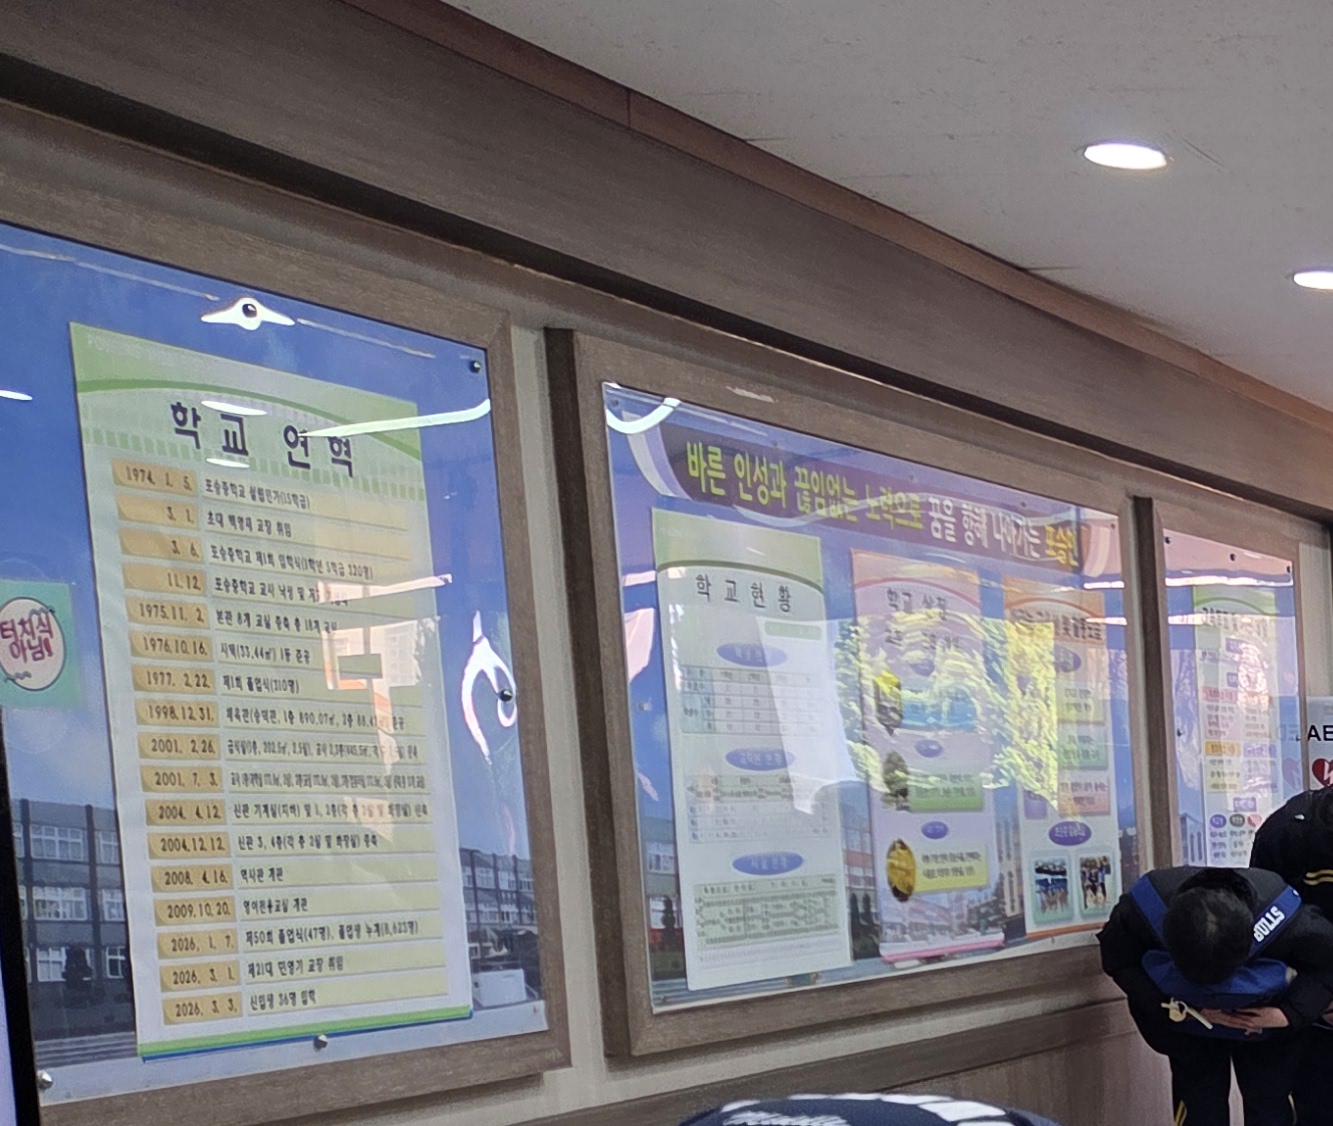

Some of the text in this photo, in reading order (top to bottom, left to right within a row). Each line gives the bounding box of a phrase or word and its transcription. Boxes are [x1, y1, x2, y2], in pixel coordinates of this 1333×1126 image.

[170, 401, 249, 457] 학교
[686, 441, 726, 496] 바른
[734, 451, 787, 508] 인성과
[794, 465, 858, 523] 끊임없는
[865, 483, 924, 530] 노력으로
[928, 496, 957, 543] 꿈을
[207, 511, 223, 528] 초대
[256, 518, 272, 535] 교장
[277, 522, 292, 538] 취임
[223, 674, 243, 691] 제1회
[240, 867, 284, 883] 역사관 개관
[292, 897, 308, 912] 개관
[171, 937, 200, 952] 2026.
[246, 929, 273, 947] 제50회
[338, 923, 361, 941] 졸업생
[248, 961, 274, 979] 제21대
[308, 957, 324, 973] 교장
[328, 955, 344, 971] 취임
[173, 969, 201, 985] 2026.
[175, 1001, 203, 1017] 2026.
[250, 993, 274, 1011] 신입생
[301, 989, 316, 1004] 입학
